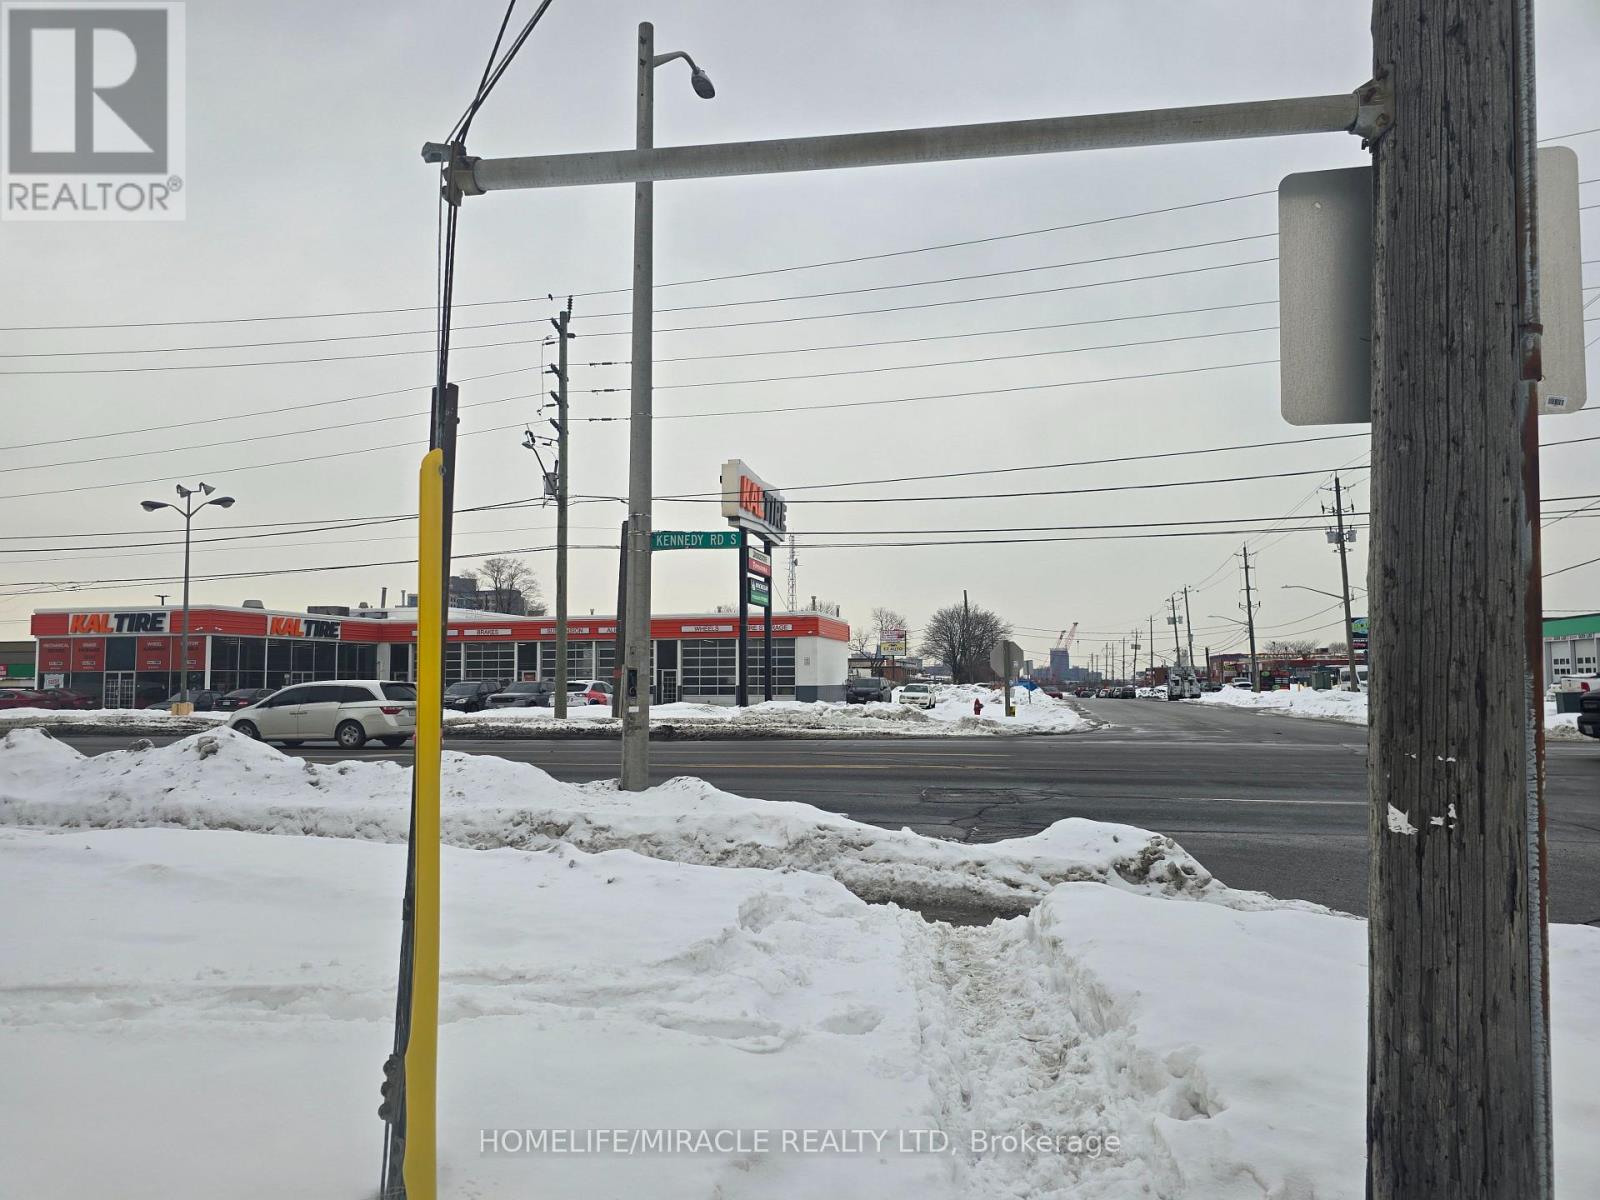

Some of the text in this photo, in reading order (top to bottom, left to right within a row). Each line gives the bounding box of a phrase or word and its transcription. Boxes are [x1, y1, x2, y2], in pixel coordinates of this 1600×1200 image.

[656, 533, 737, 547] KENNEDY RD S
[476, 628, 499, 636] BRAKES
